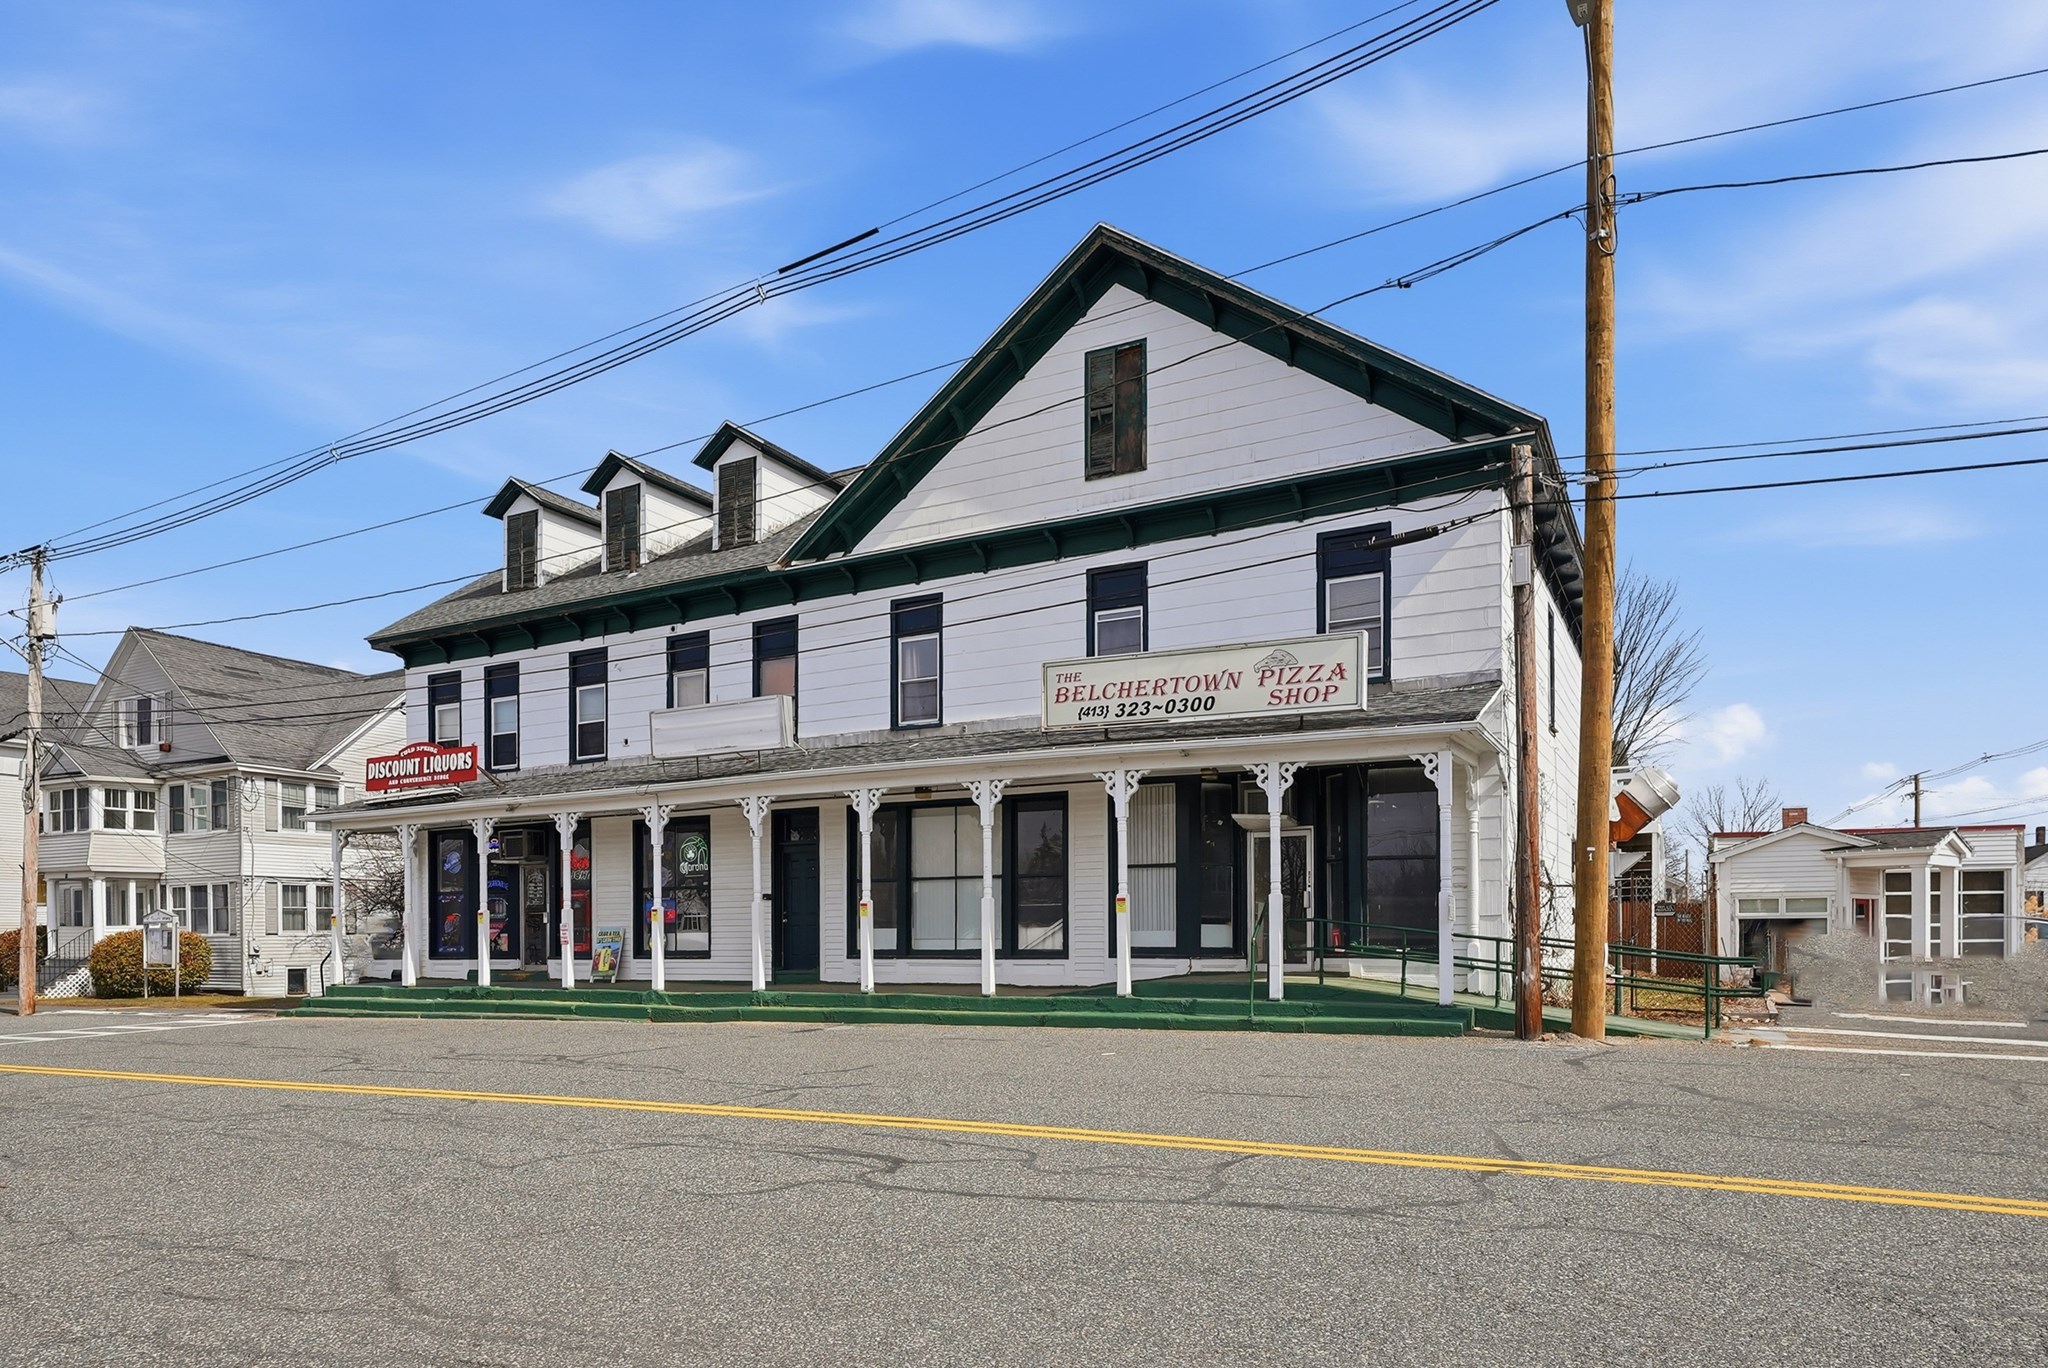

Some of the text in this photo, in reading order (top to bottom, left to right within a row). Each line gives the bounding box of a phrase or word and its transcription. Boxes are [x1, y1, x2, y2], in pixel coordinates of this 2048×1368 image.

[1054, 662, 1348, 704] BELCHERTOWN PIZZA
[1055, 672, 1082, 684] THE
[1267, 685, 1339, 706] SHOP
[368, 751, 472, 780] DISCOUNT LIQUORS
